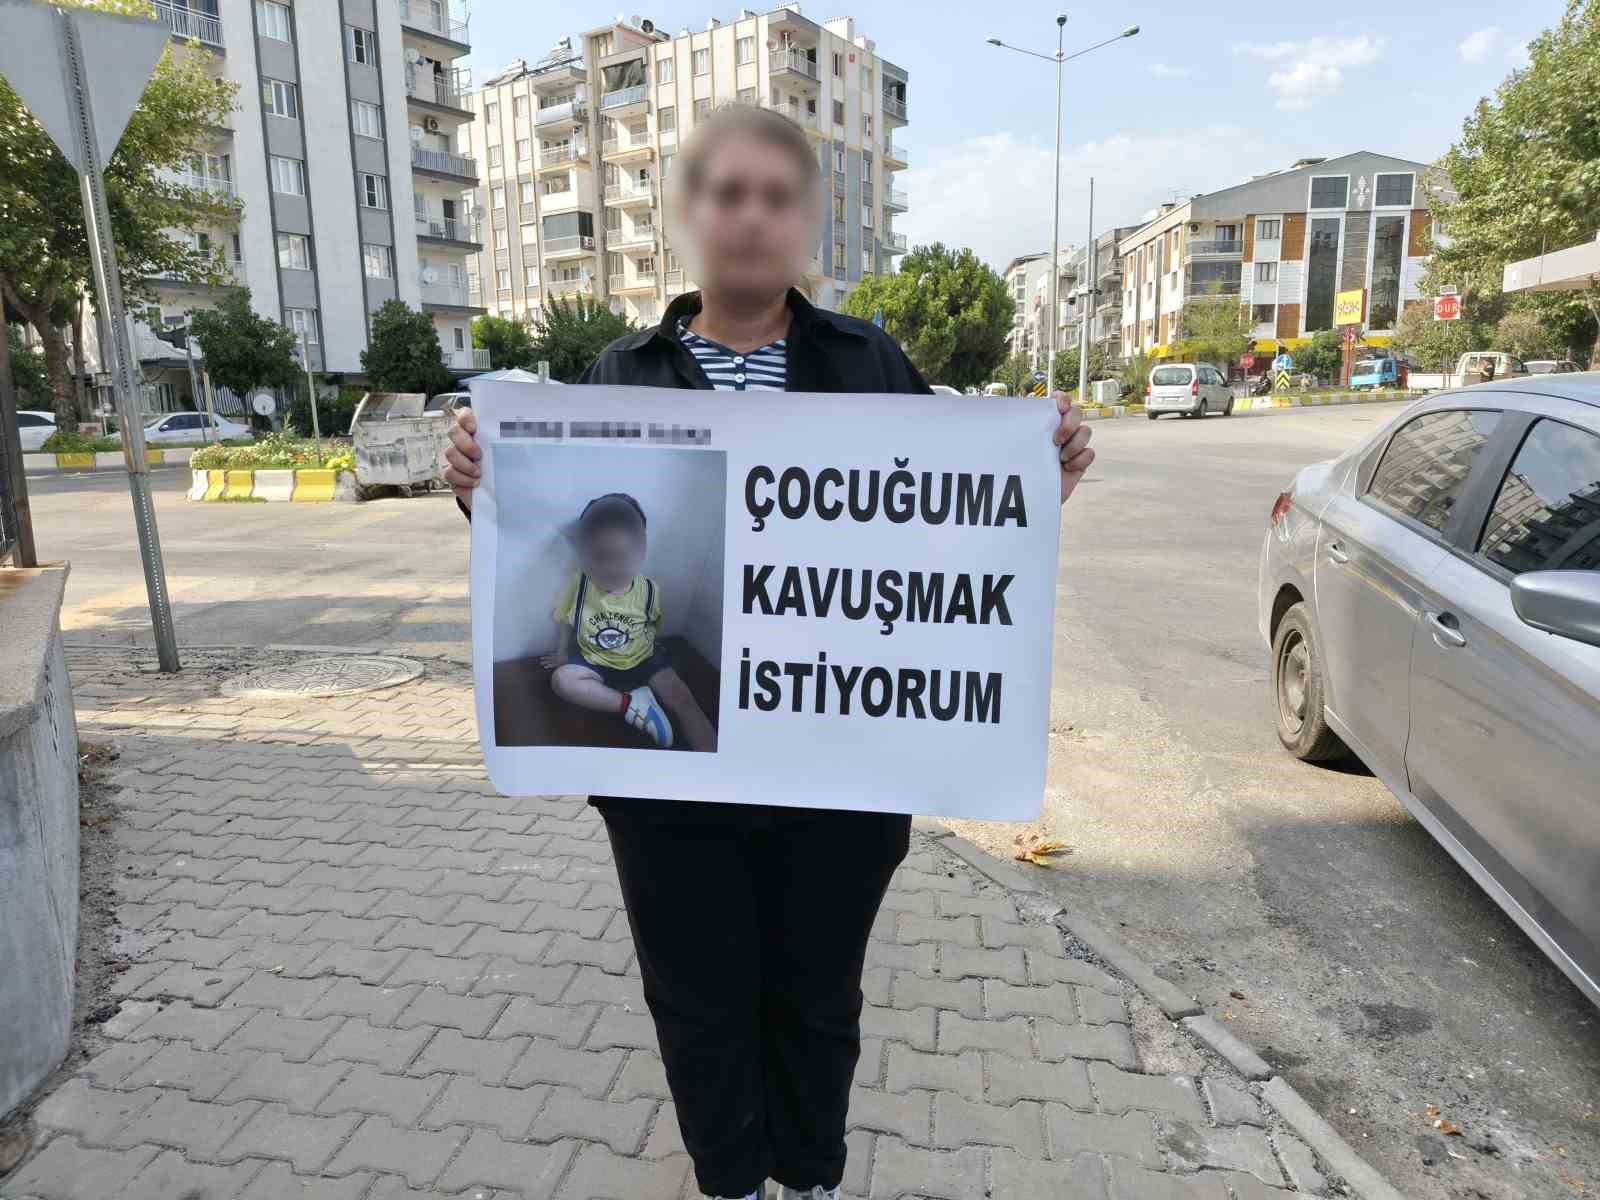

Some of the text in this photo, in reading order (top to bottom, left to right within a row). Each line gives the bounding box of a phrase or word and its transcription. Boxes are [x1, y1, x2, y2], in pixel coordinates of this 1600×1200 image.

[1436, 303, 1458, 313] DUR
[744, 457, 1028, 533] ÇOCUĞUMA
[742, 564, 1015, 636] KAVUŞMAK
[738, 647, 1002, 724] İSTİYORUM
